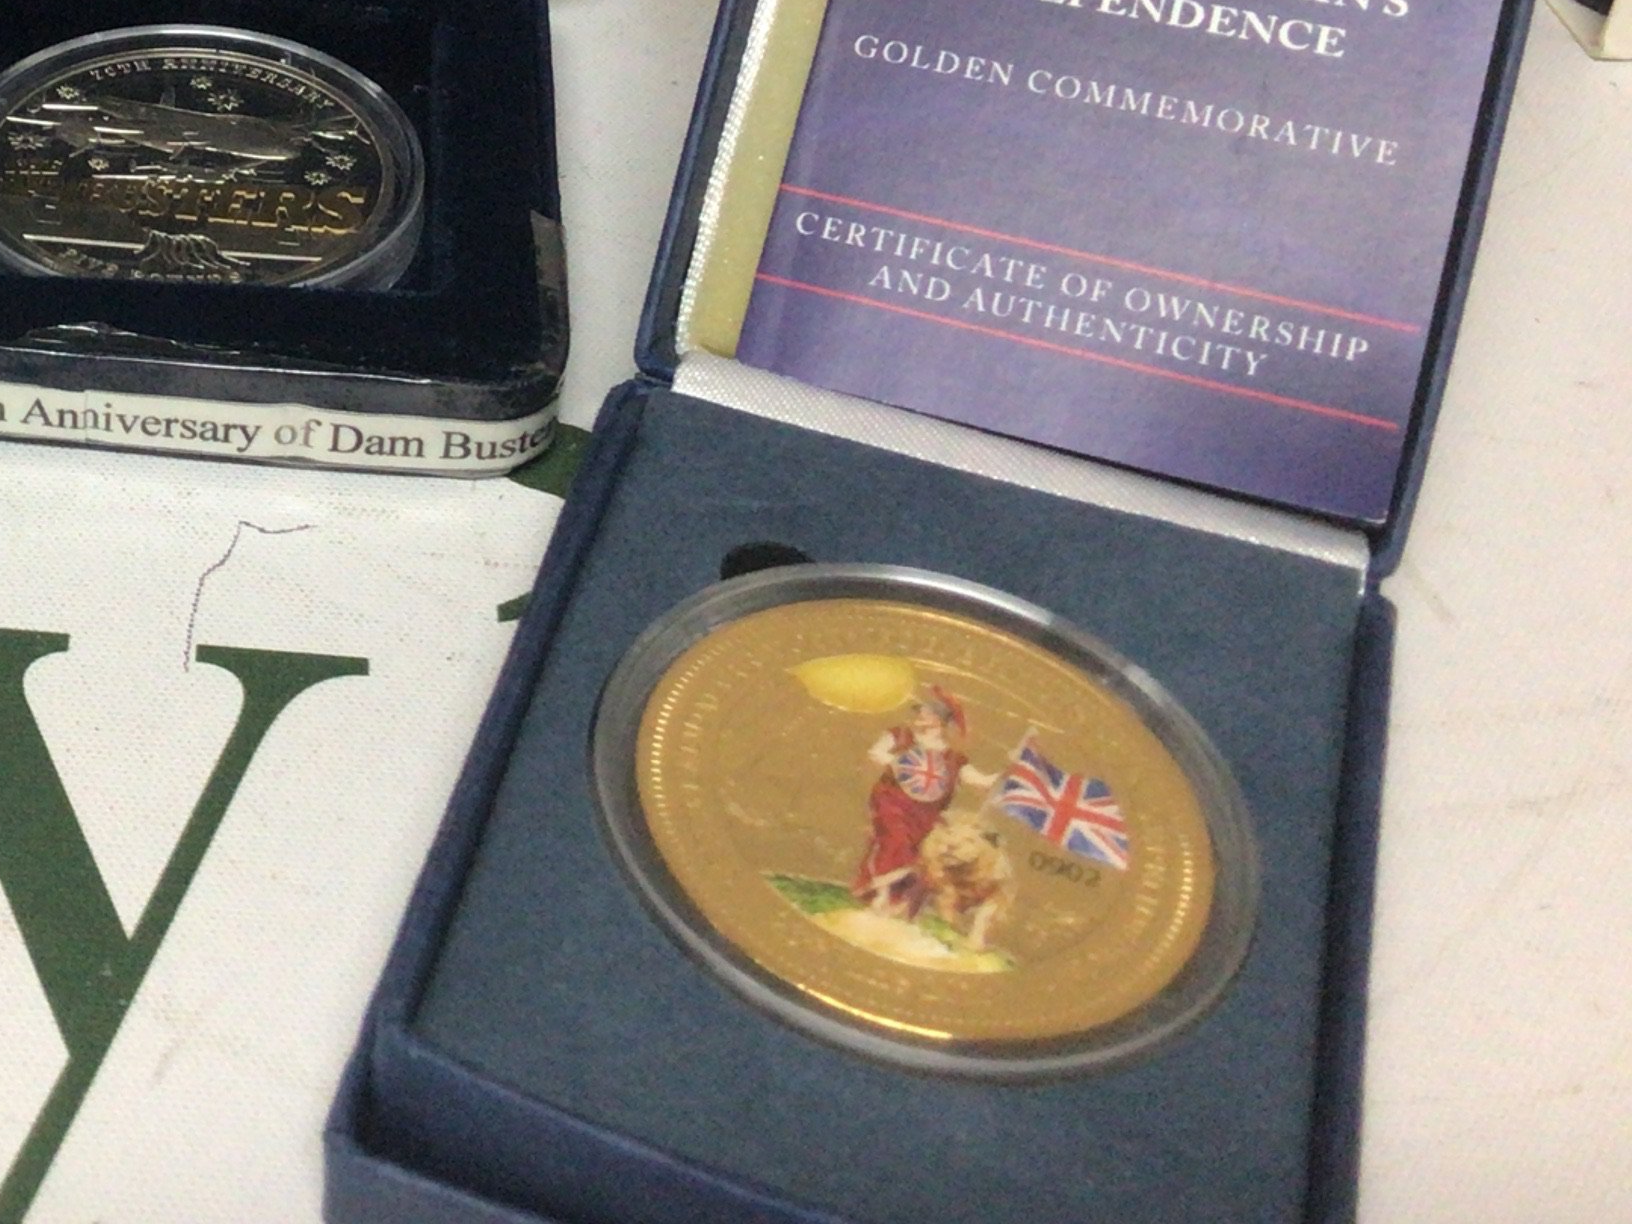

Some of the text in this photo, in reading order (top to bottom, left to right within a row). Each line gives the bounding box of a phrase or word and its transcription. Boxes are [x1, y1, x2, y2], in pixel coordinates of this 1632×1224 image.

[853, 34, 1400, 167] GOLDEN COMMEMORATIVE
[794, 210, 1370, 363] CERTIFICATE OF OWNERSHIP
[868, 265, 1268, 378] AND AUTHENTICITY
[19, 394, 263, 453] Anniversary
[273, 418, 324, 450] of
[328, 424, 425, 460] Dam
